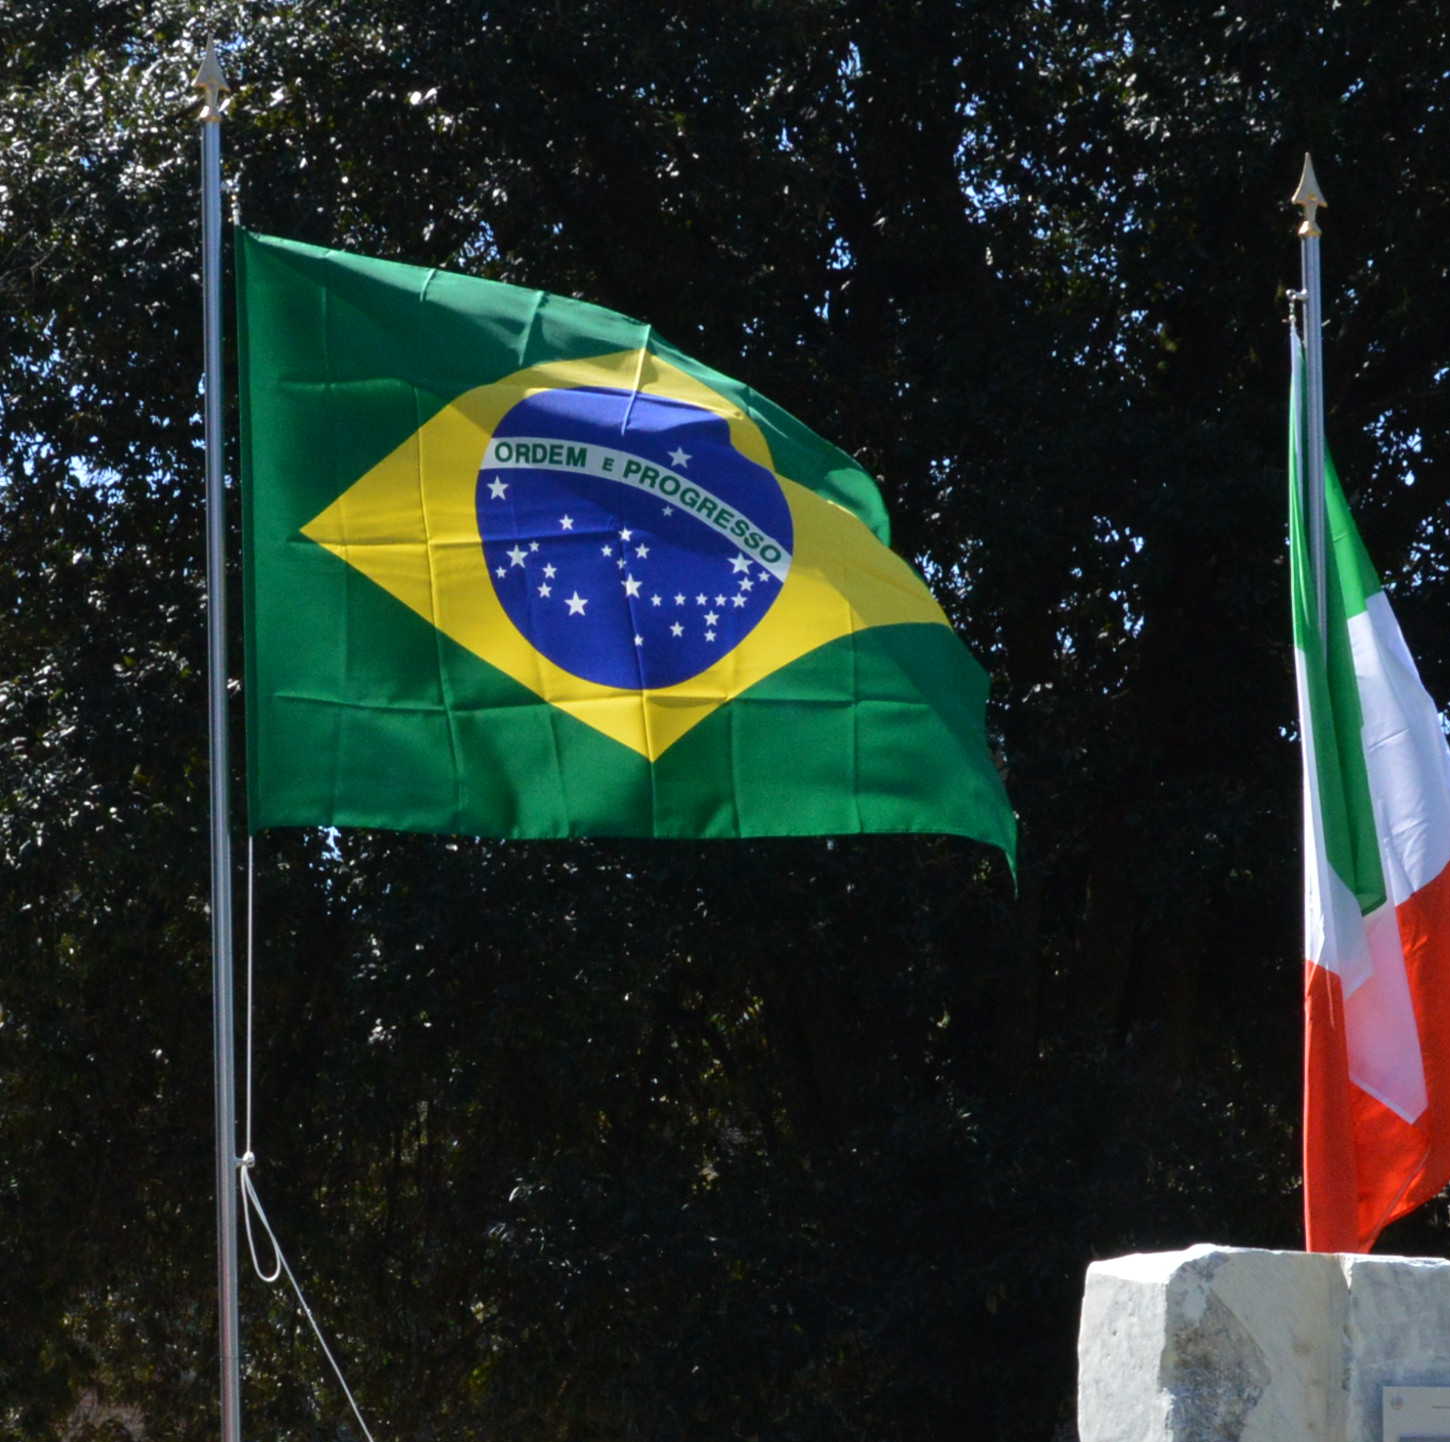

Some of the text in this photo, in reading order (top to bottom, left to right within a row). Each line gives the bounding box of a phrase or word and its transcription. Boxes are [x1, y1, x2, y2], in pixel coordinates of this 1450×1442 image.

[494, 441, 783, 565] ORDEM E PROGRESSO
